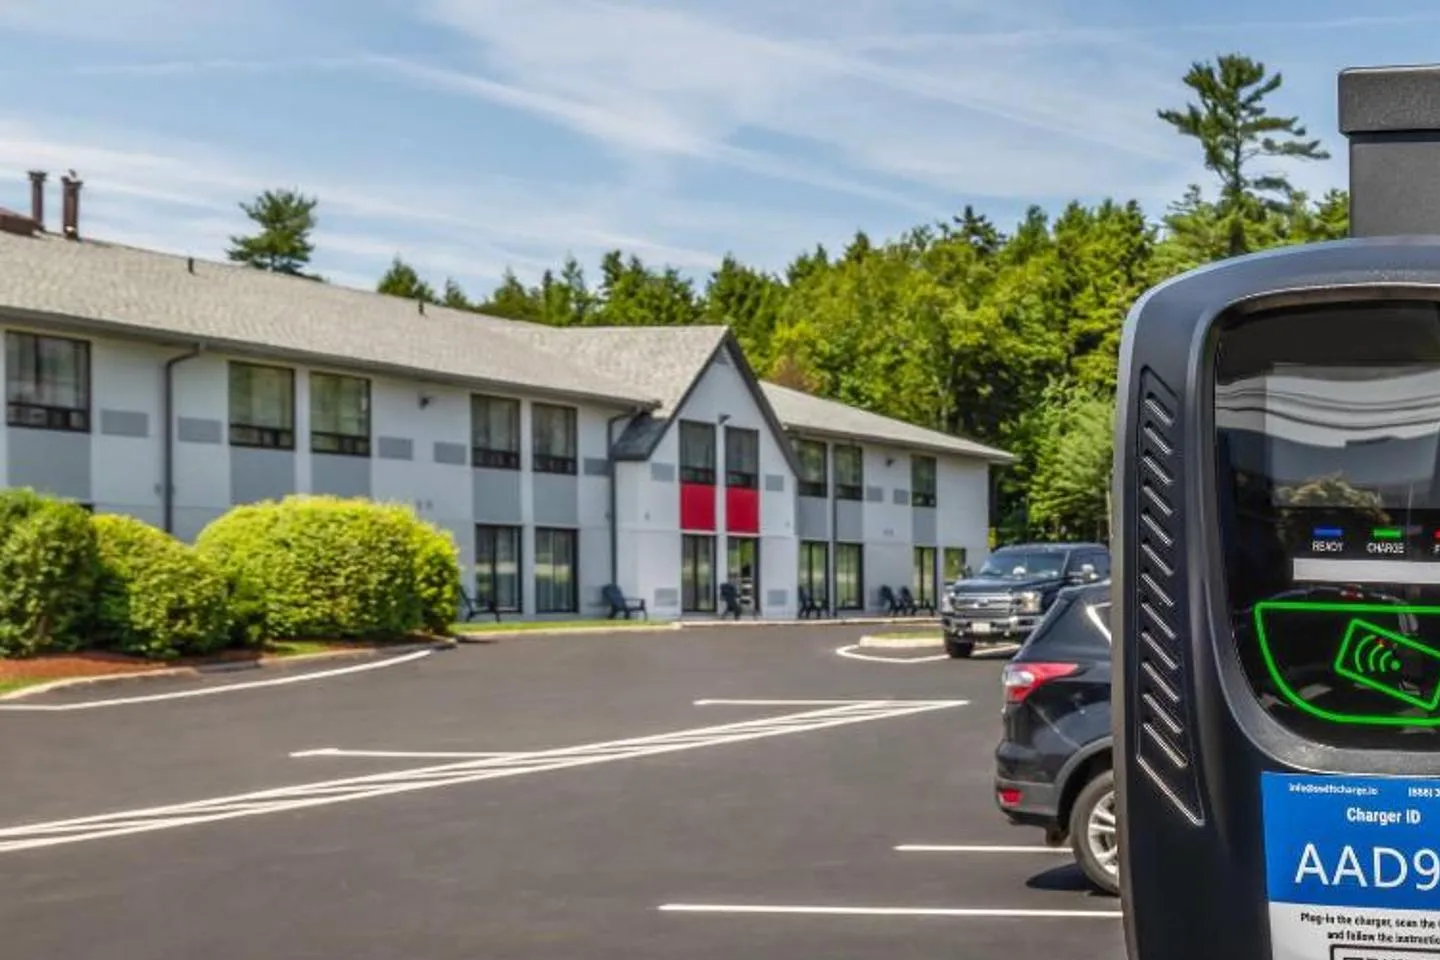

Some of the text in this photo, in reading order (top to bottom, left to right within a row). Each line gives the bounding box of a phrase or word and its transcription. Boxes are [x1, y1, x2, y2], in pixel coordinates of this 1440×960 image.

[1366, 542, 1405, 554] CHARGE
[1346, 807, 1421, 826] Charger ID
[1300, 912, 1335, 925] Plug-in
[1337, 914, 1352, 924] the
[1354, 915, 1392, 929] charger,
[1395, 919, 1417, 928] scan
[1420, 918, 1436, 929] the
[1327, 930, 1344, 940] and
[1346, 930, 1376, 941] follow
[1377, 932, 1394, 943] the
